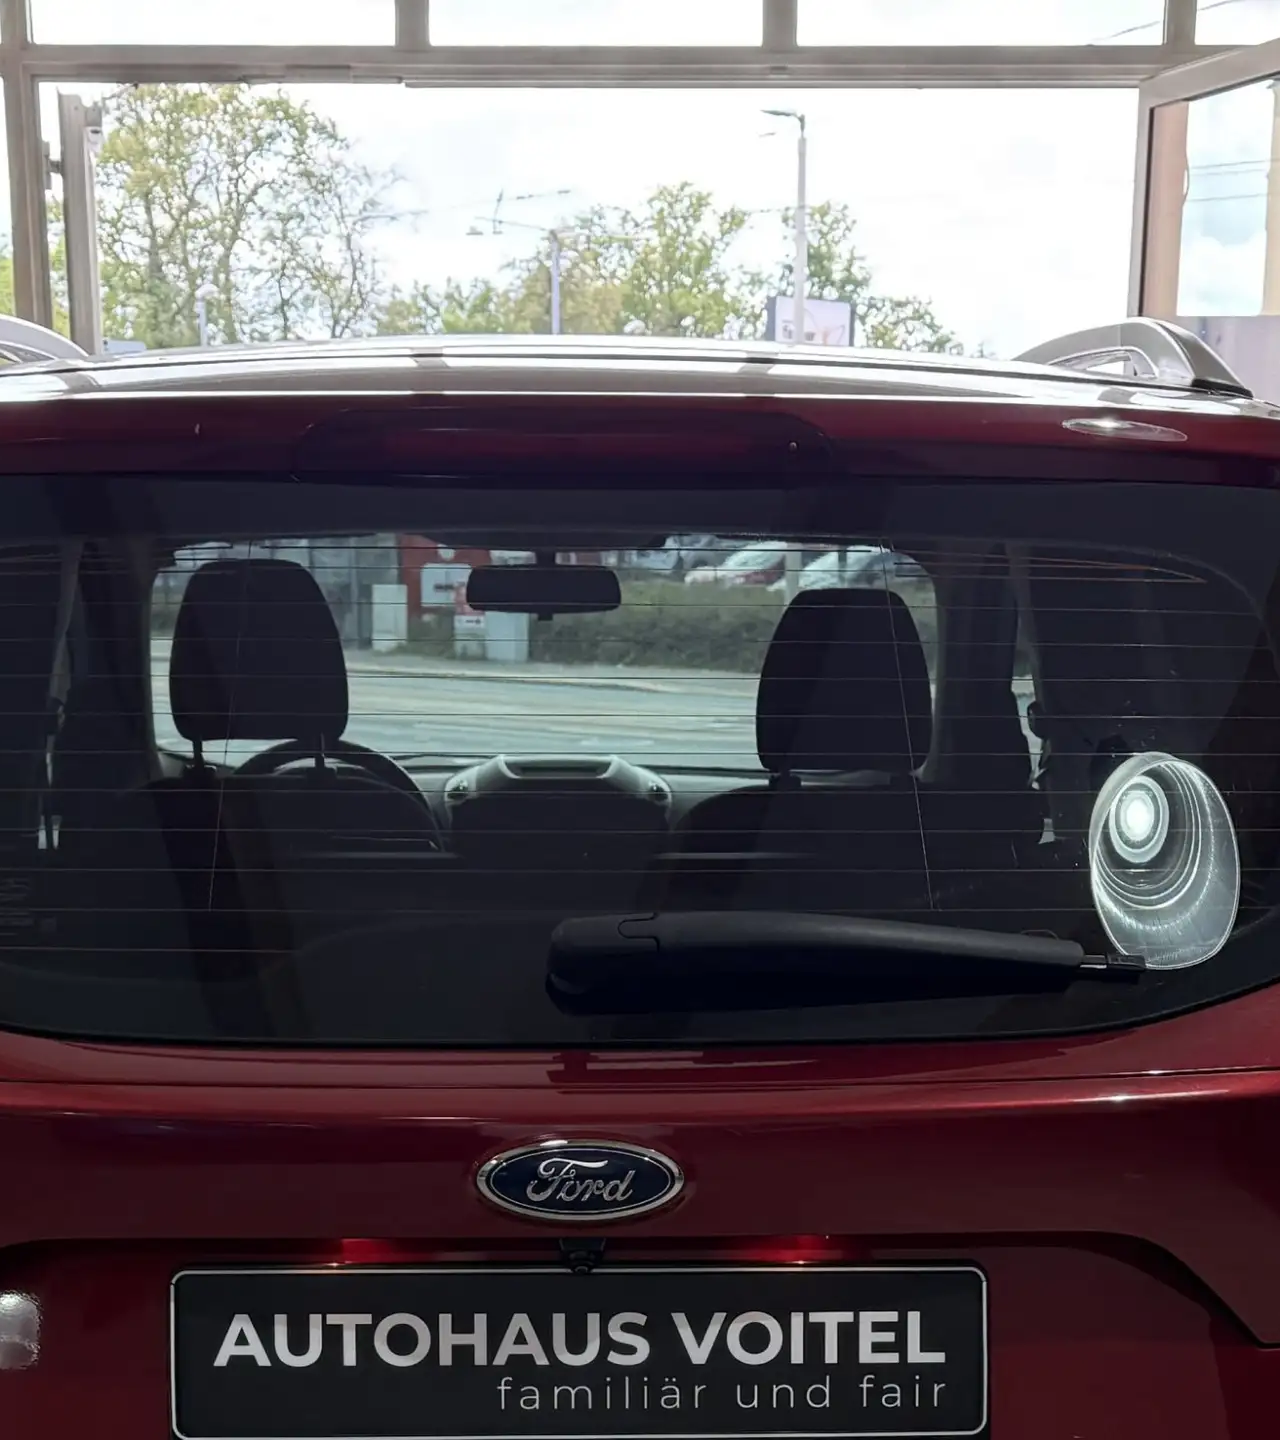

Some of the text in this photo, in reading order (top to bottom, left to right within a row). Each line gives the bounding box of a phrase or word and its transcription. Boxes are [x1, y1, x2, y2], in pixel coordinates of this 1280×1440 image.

[526, 1157, 637, 1202] Ford
[213, 1310, 947, 1368] AUTOHAUS VOITEL
[497, 1374, 947, 1410] familiär und fair
